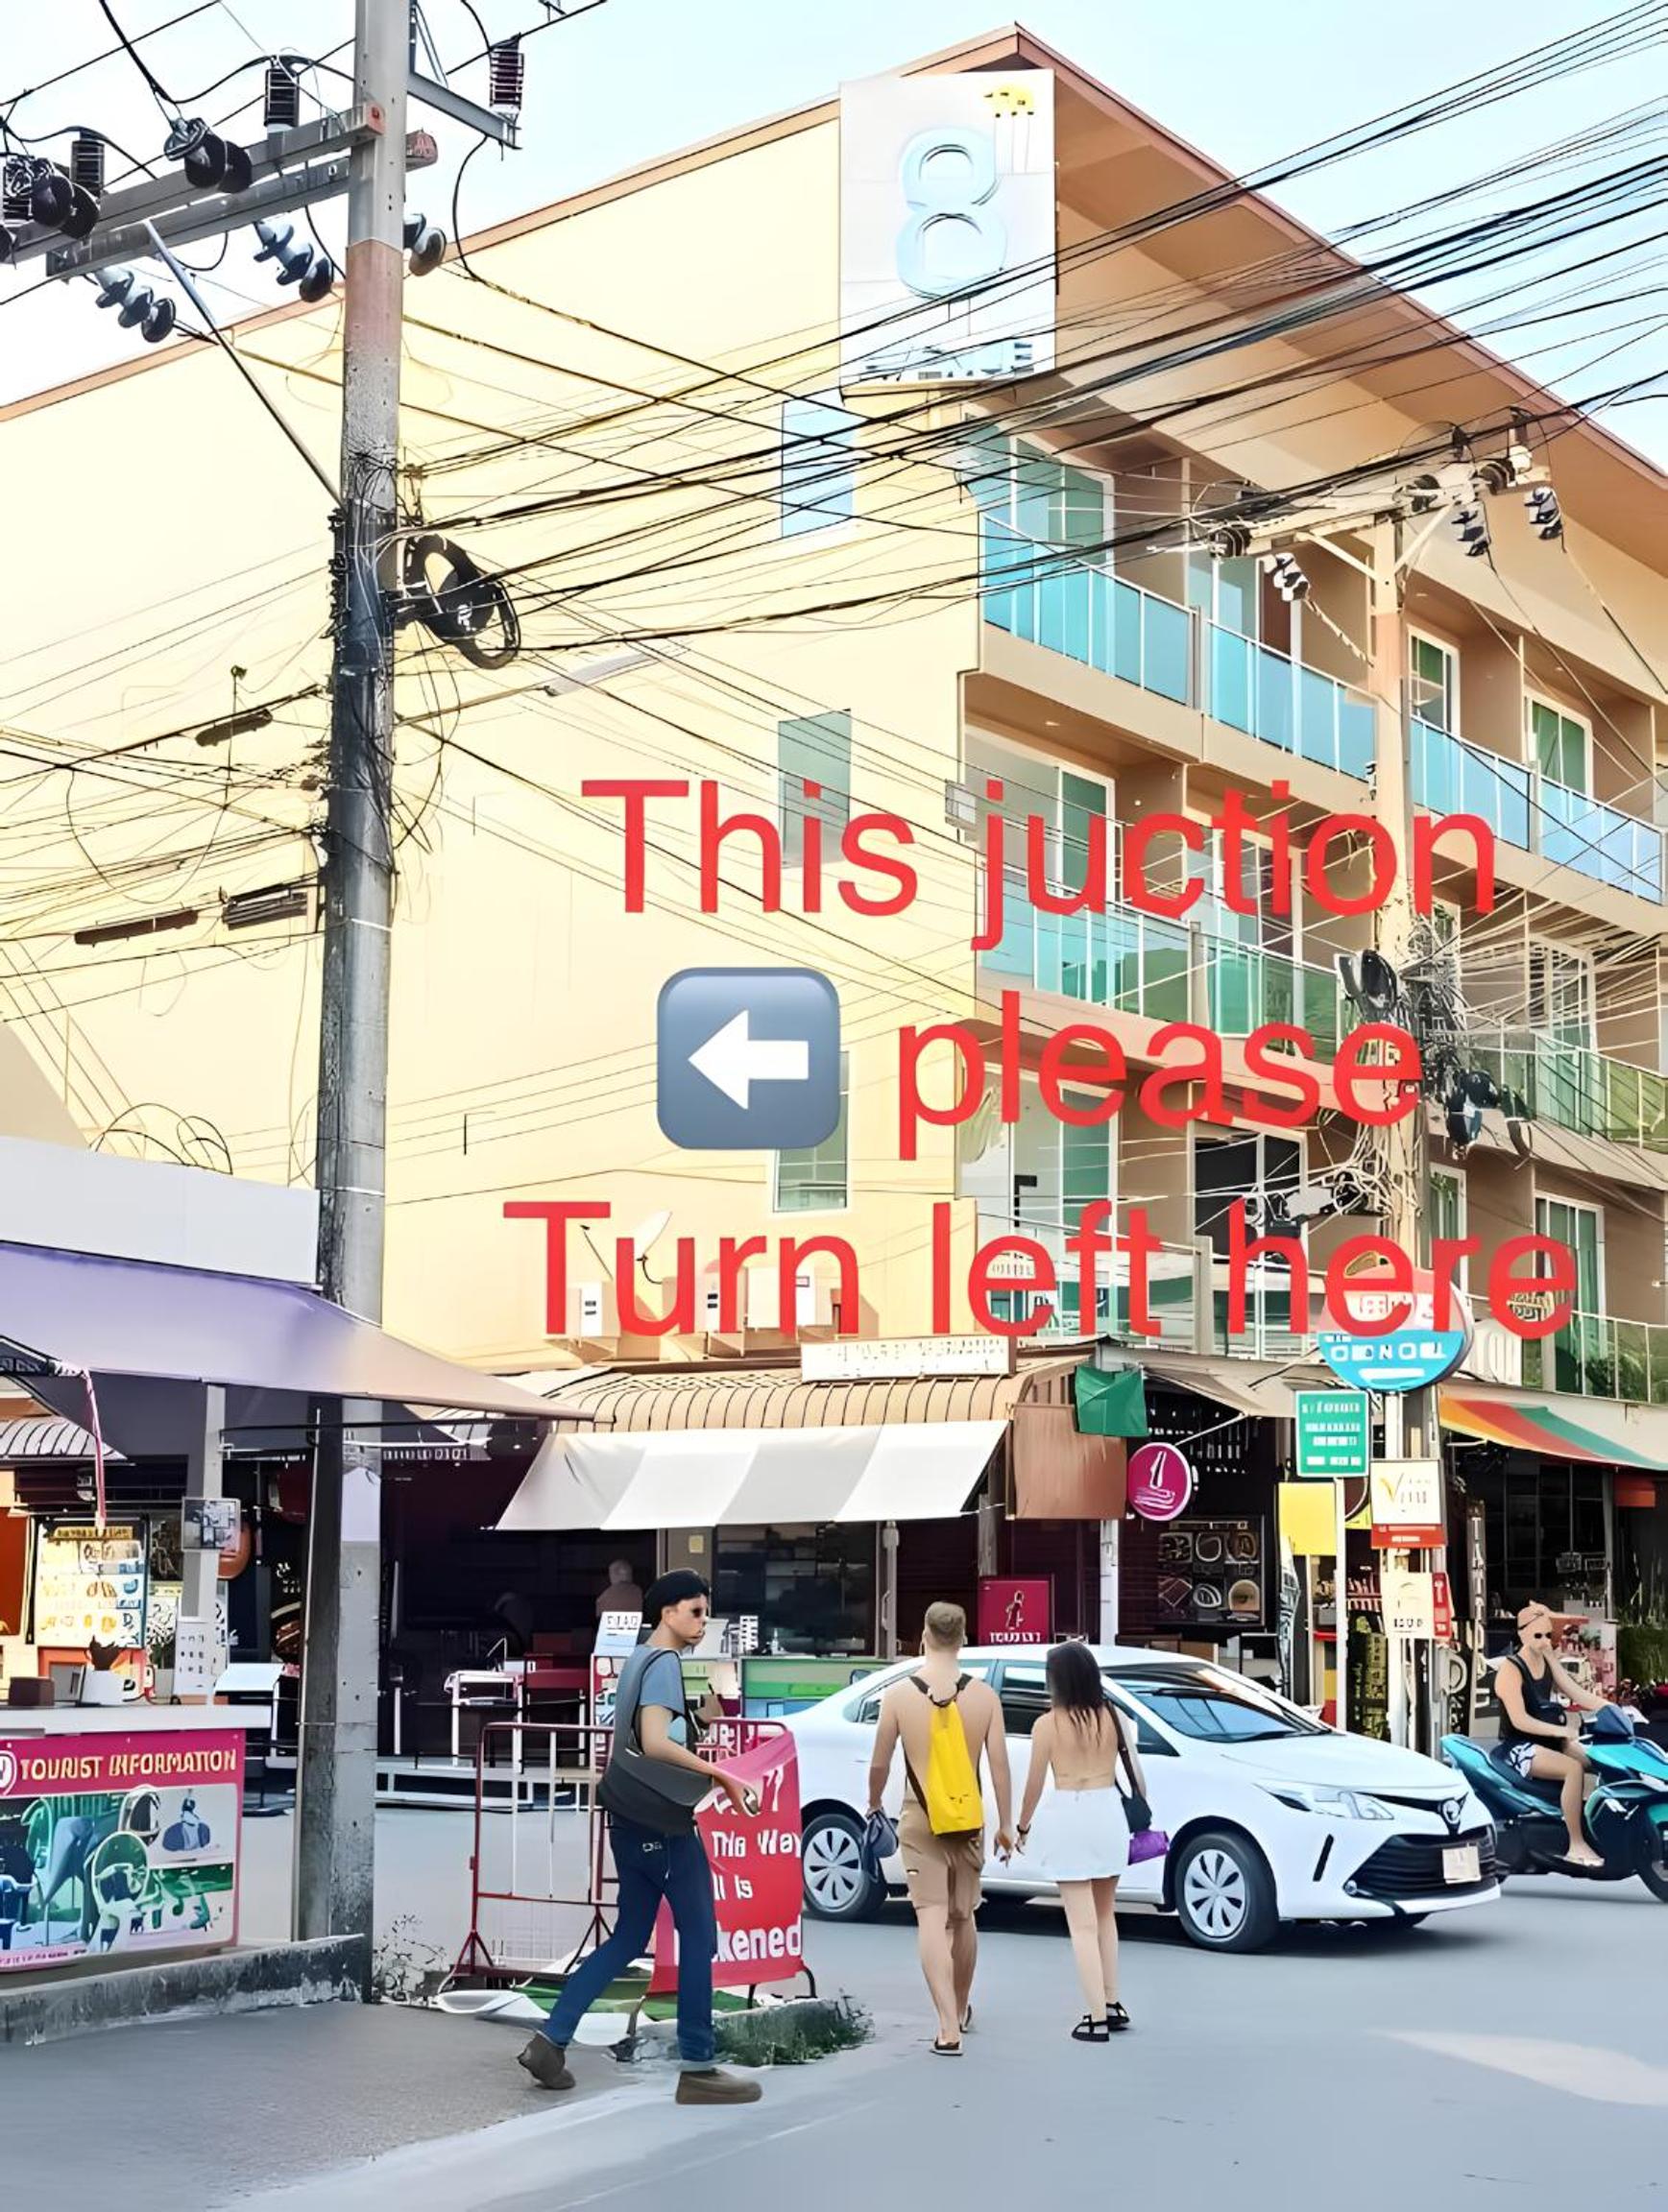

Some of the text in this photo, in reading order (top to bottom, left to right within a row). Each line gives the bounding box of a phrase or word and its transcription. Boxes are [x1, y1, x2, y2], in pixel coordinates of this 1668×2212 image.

[896, 125, 1008, 302] 8
[20, 1756, 103, 1781] TOURIST
[109, 1748, 237, 1777] INFORMATION
